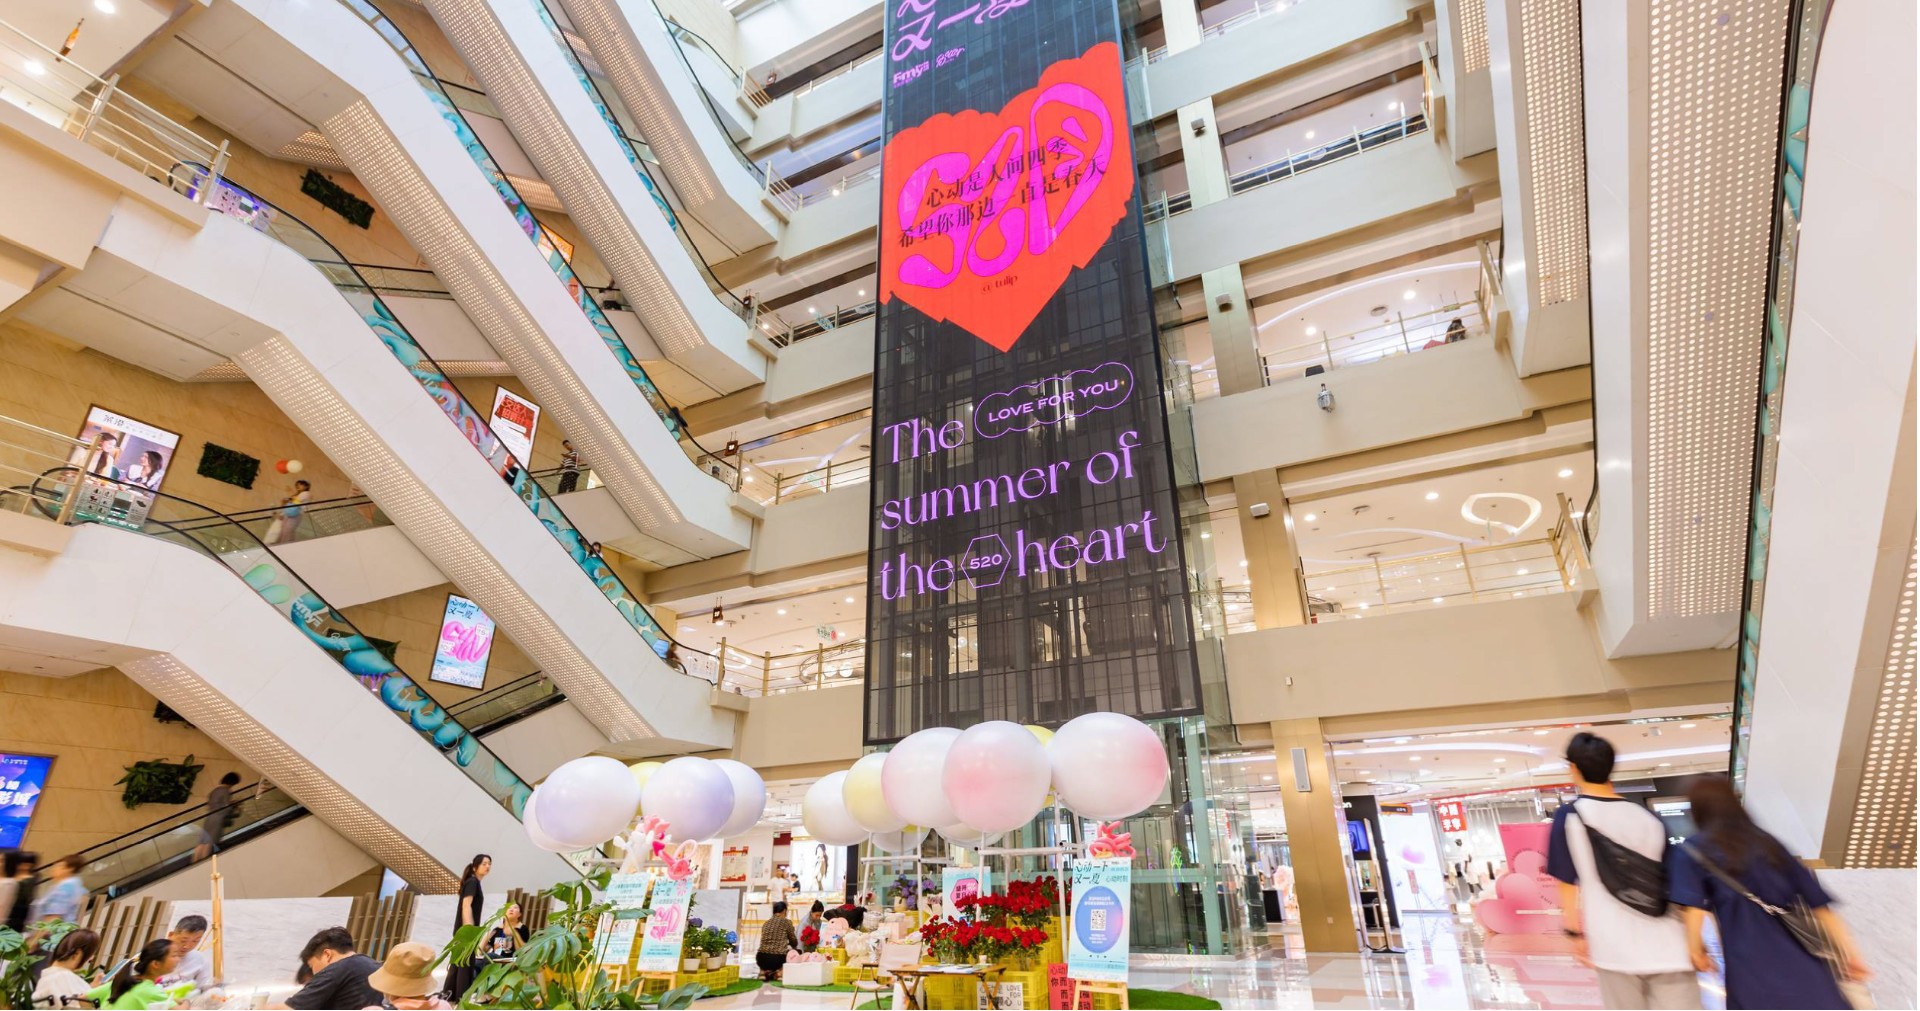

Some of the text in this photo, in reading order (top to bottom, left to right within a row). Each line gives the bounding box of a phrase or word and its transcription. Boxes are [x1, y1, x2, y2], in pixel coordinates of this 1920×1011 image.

[926, 136, 1069, 209] 心动是人间四季
[898, 156, 1107, 249] 希望你那边一直是春天
[988, 379, 1119, 423] LOVE FOR YOU
[882, 419, 965, 464] The
[880, 430, 1142, 531] summer of
[969, 552, 1003, 571] 520
[1015, 510, 1168, 578] heart
[880, 552, 955, 601] the
